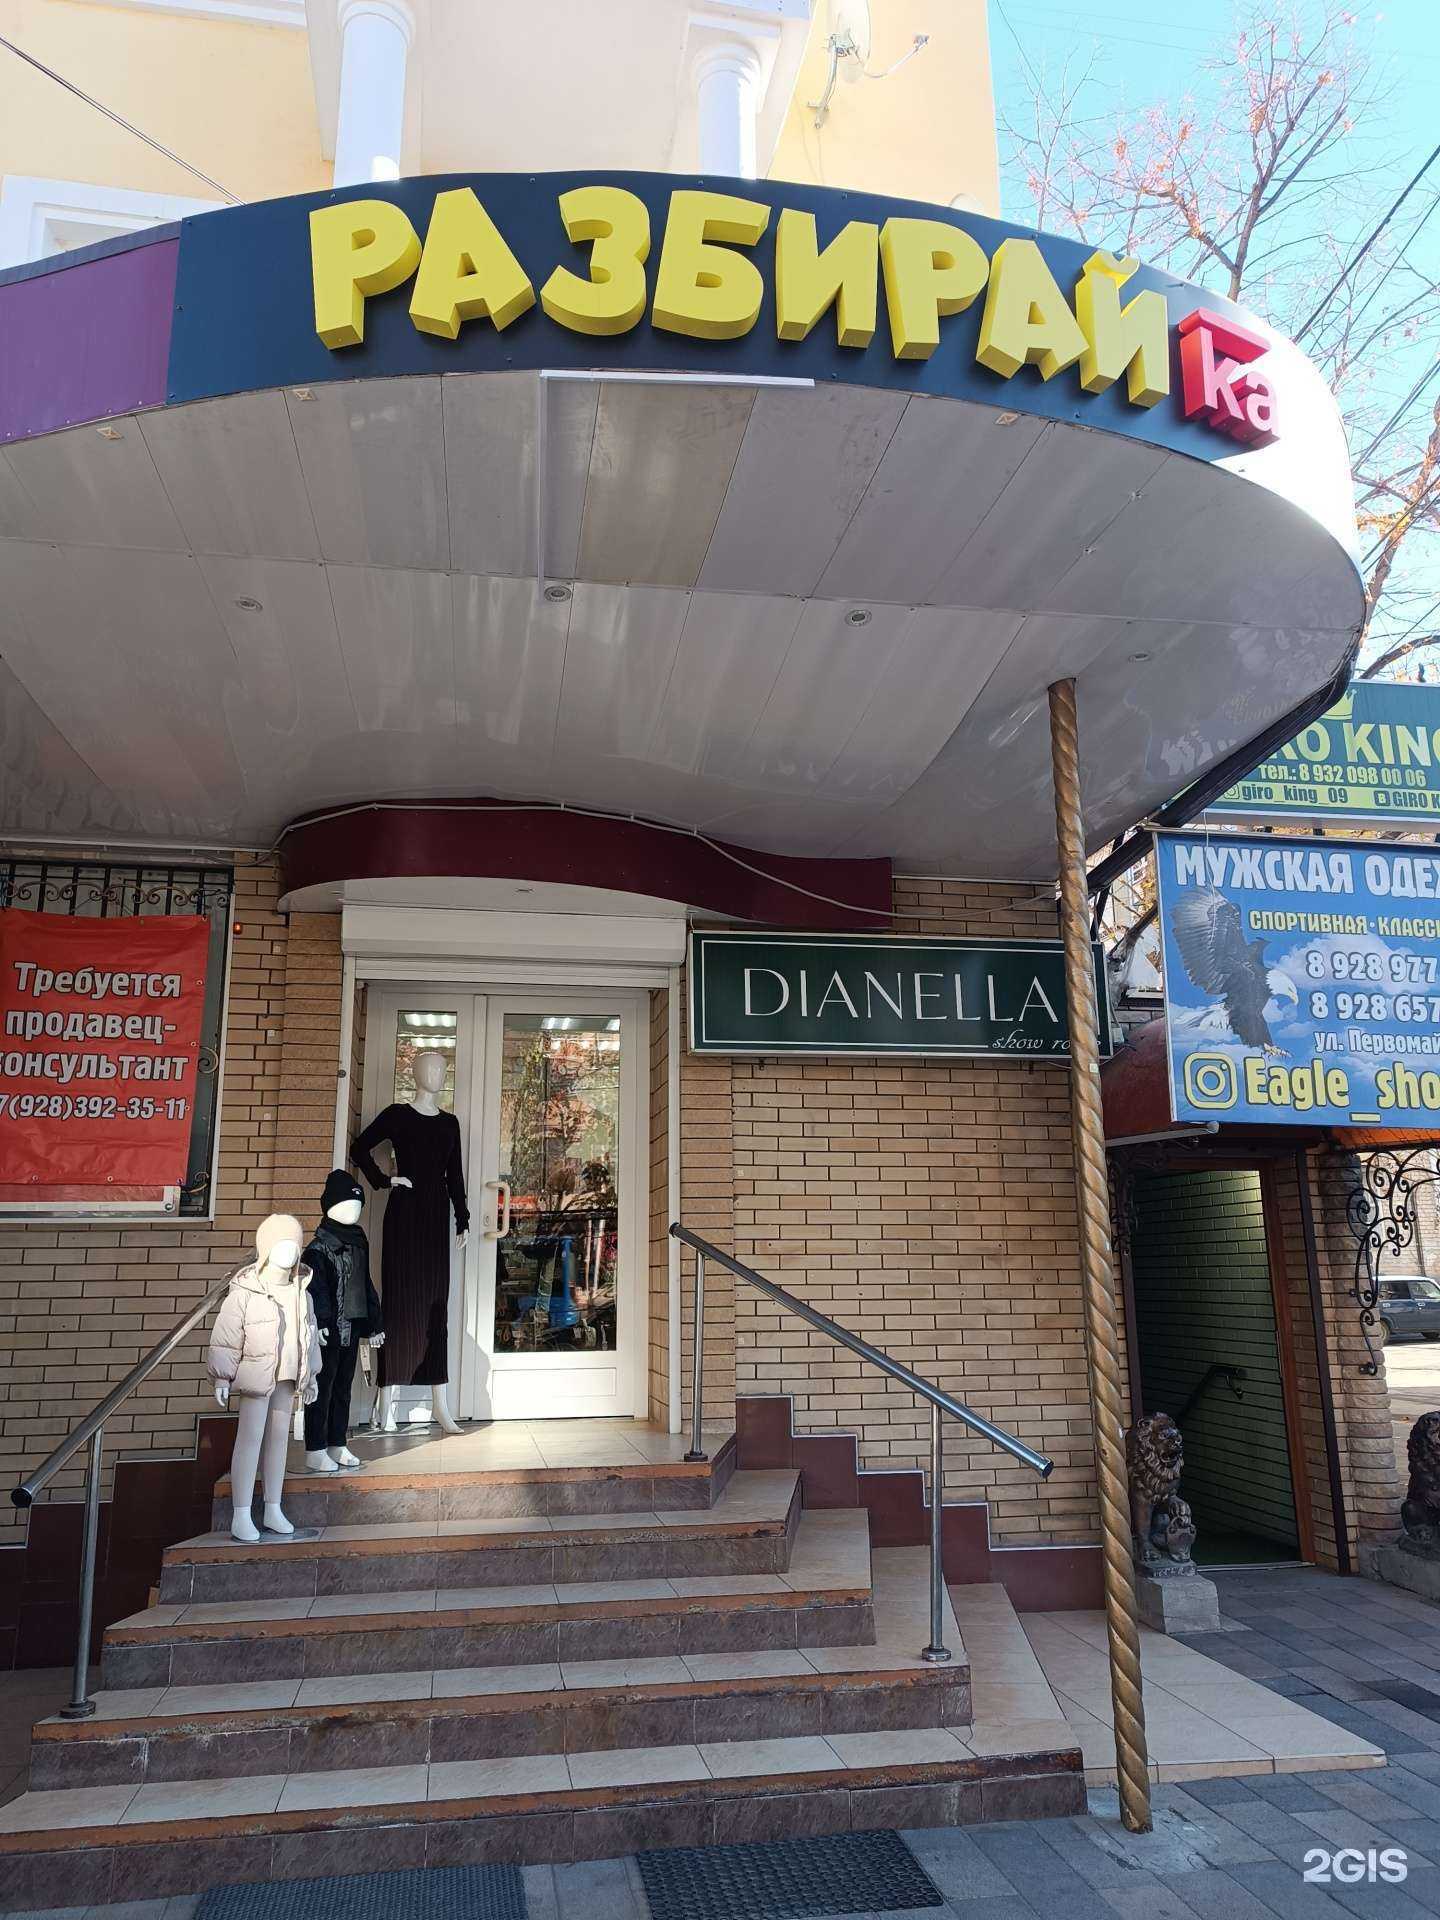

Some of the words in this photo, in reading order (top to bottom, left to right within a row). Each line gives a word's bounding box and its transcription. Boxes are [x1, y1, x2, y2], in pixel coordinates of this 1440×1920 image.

[1342, 722, 1440, 767] KIN
[1258, 764, 1296, 782] тел.:
[1299, 763, 1310, 782] 8
[1312, 764, 1344, 783] 932
[1347, 767, 1378, 786] 098
[1381, 768, 1402, 787] 00
[1405, 769, 1427, 788] 06
[1392, 790, 1428, 809] GIRO
[1174, 845, 1354, 894] МУЖСКАЯ
[1364, 854, 1440, 899] ОДЕ
[1249, 910, 1367, 935] СПОРТИВНАЯ
[14, 962, 182, 999] Требуется
[1306, 950, 1326, 979] 8
[1331, 951, 1384, 981] 928
[1389, 954, 1438, 983] 977
[743, 968, 1060, 1023] DIANELLA
[1310, 991, 1330, 1020] 8
[1336, 992, 1388, 1021] 928
[1394, 994, 1440, 1023] 657
[5, 1010, 177, 1044] продавец-
[992, 1029, 1044, 1049] show
[1314, 1032, 1344, 1053] ул.
